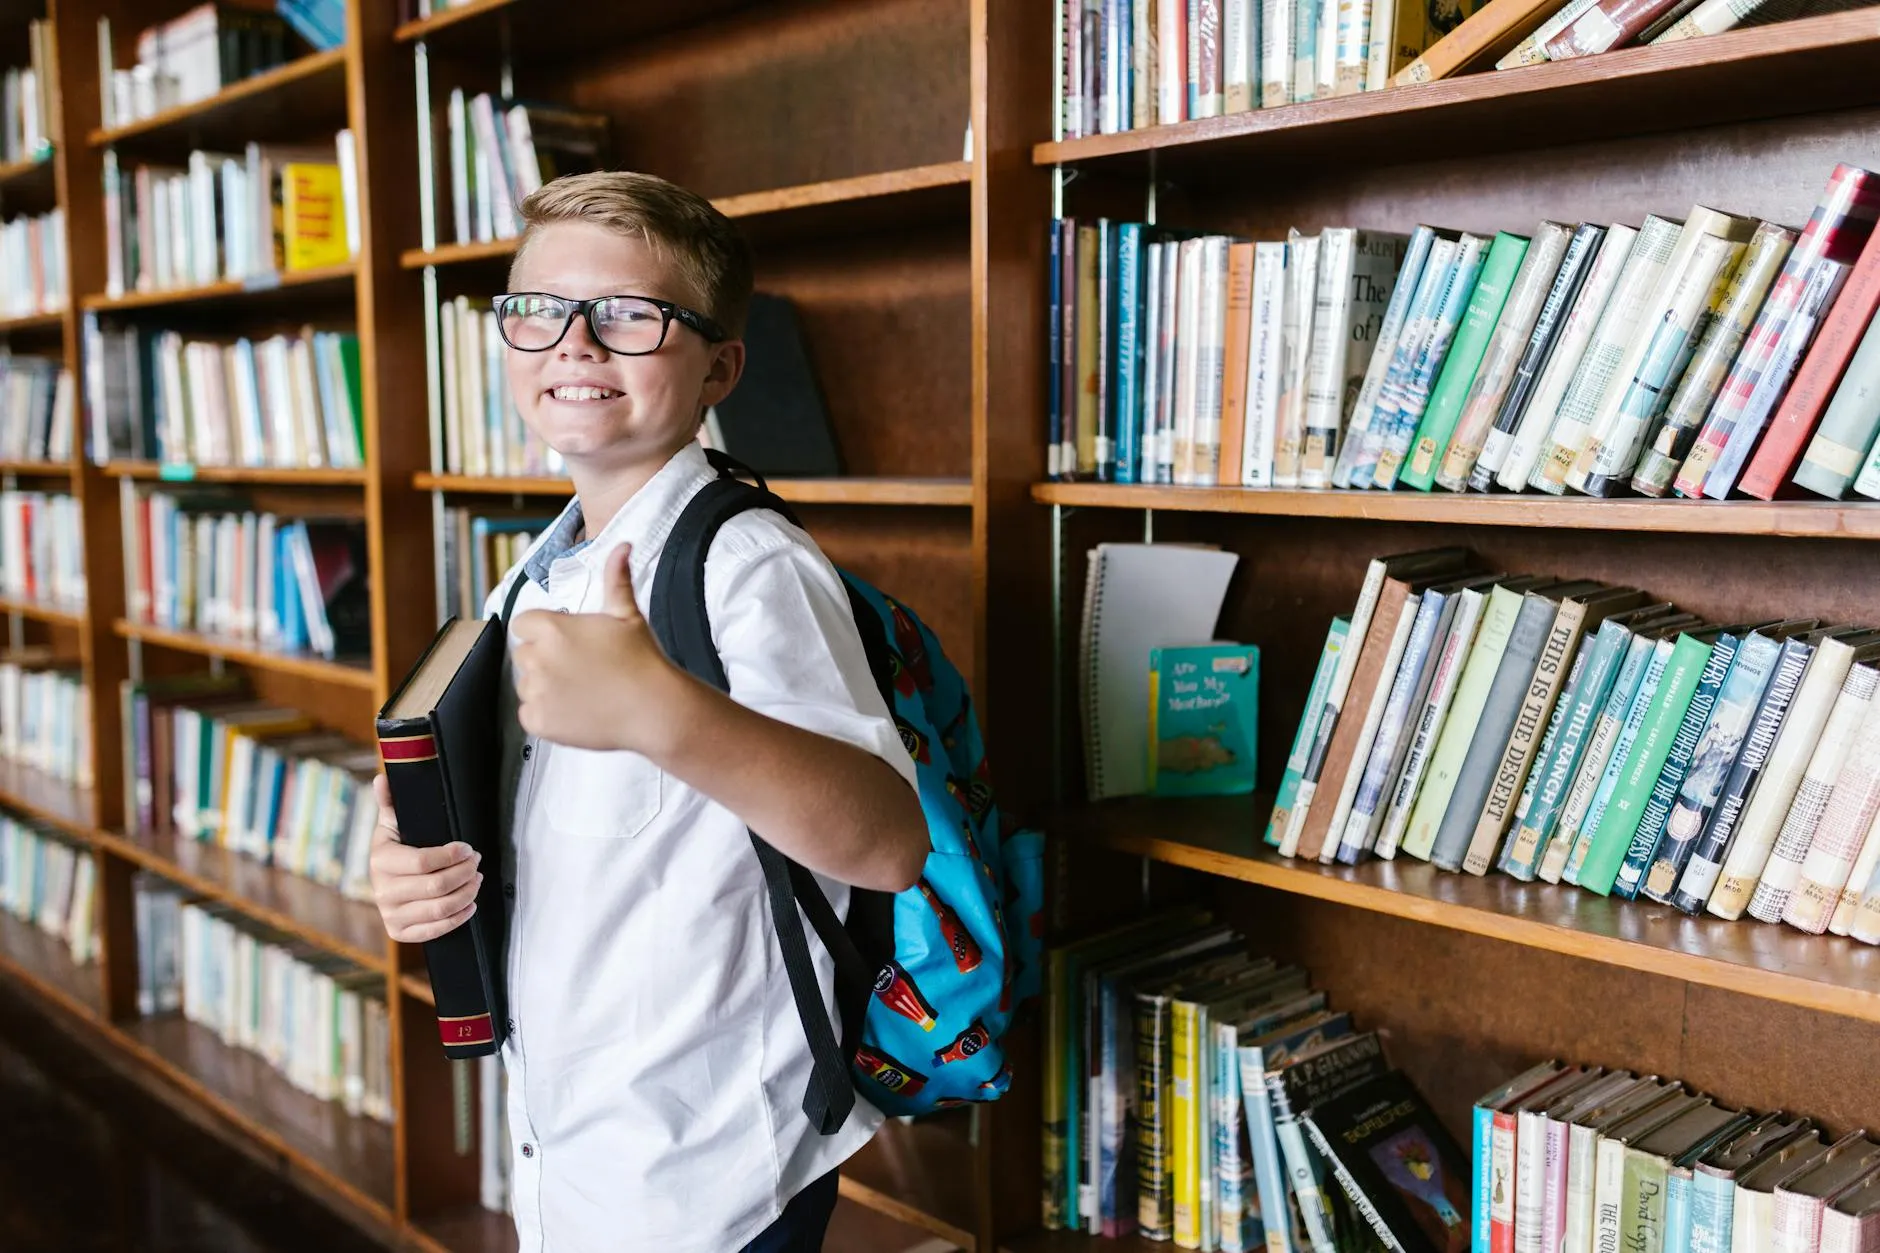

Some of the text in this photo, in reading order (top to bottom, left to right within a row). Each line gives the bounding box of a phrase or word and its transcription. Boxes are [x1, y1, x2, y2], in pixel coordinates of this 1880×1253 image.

[1353, 274, 1386, 304] The
[1352, 316, 1377, 343] of
[1554, 454, 1572, 466] MUS
[1538, 623, 1571, 675] THIS
[1698, 640, 1736, 690] MYERS
[1204, 677, 1226, 694] My
[1529, 676, 1552, 700] IS
[1645, 659, 1666, 687] THE
[1766, 647, 1809, 709] VIRGINIA
[1513, 700, 1542, 744] THE
[1549, 690, 1571, 724] INTO
[1563, 700, 1592, 744] HILL
[1596, 689, 1629, 742] Mystery
[1626, 690, 1653, 732] THREE
[1539, 721, 1559, 751] THE
[1666, 688, 1716, 767] SOMEWHERE
[1739, 704, 1784, 772] HAMILTON
[1586, 753, 1601, 773] the
[1593, 740, 1606, 755] at
[1484, 744, 1526, 822] DESERT
[1521, 749, 1548, 798] UNKNO
[1539, 741, 1575, 805] RANCH
[1660, 761, 1686, 781] IN
[1565, 769, 1594, 814] Pilgrim
[1650, 777, 1678, 805] THE
[1561, 813, 1576, 829] Di
[1718, 793, 1744, 825] PLAIN
[1625, 798, 1669, 863] DARKNESS
[1708, 820, 1731, 846] CITY
[874, 973, 892, 989] SUPER
[458, 1025, 472, 1037] 12
[1598, 1201, 1617, 1225] THE
[1637, 1179, 1659, 1221] David
